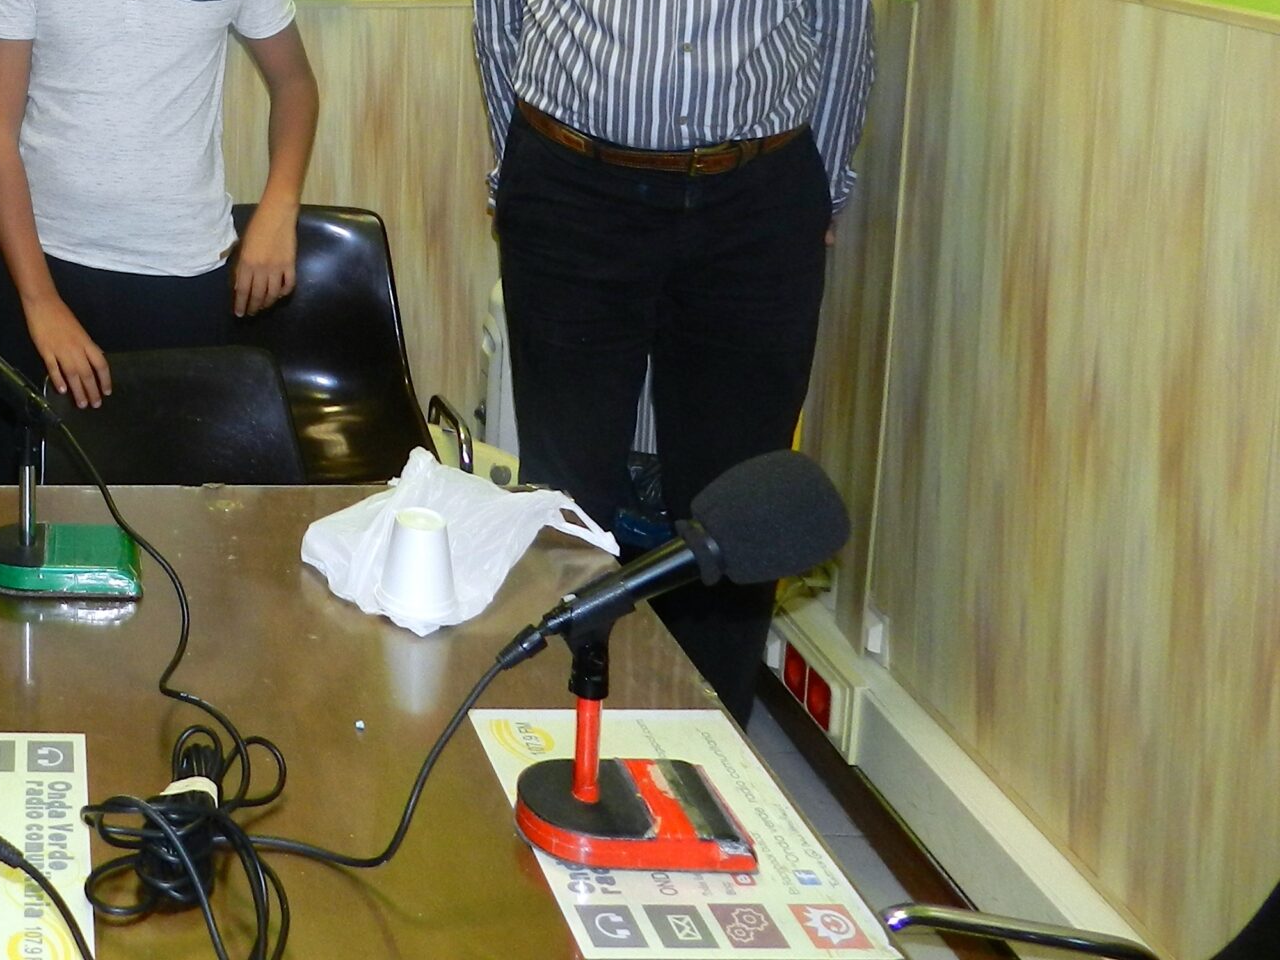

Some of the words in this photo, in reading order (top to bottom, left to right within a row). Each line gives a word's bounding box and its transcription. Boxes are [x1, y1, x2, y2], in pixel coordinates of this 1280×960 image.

[25, 780, 48, 820] radio
[48, 780, 73, 819] Onda
[48, 823, 75, 871] Verde
